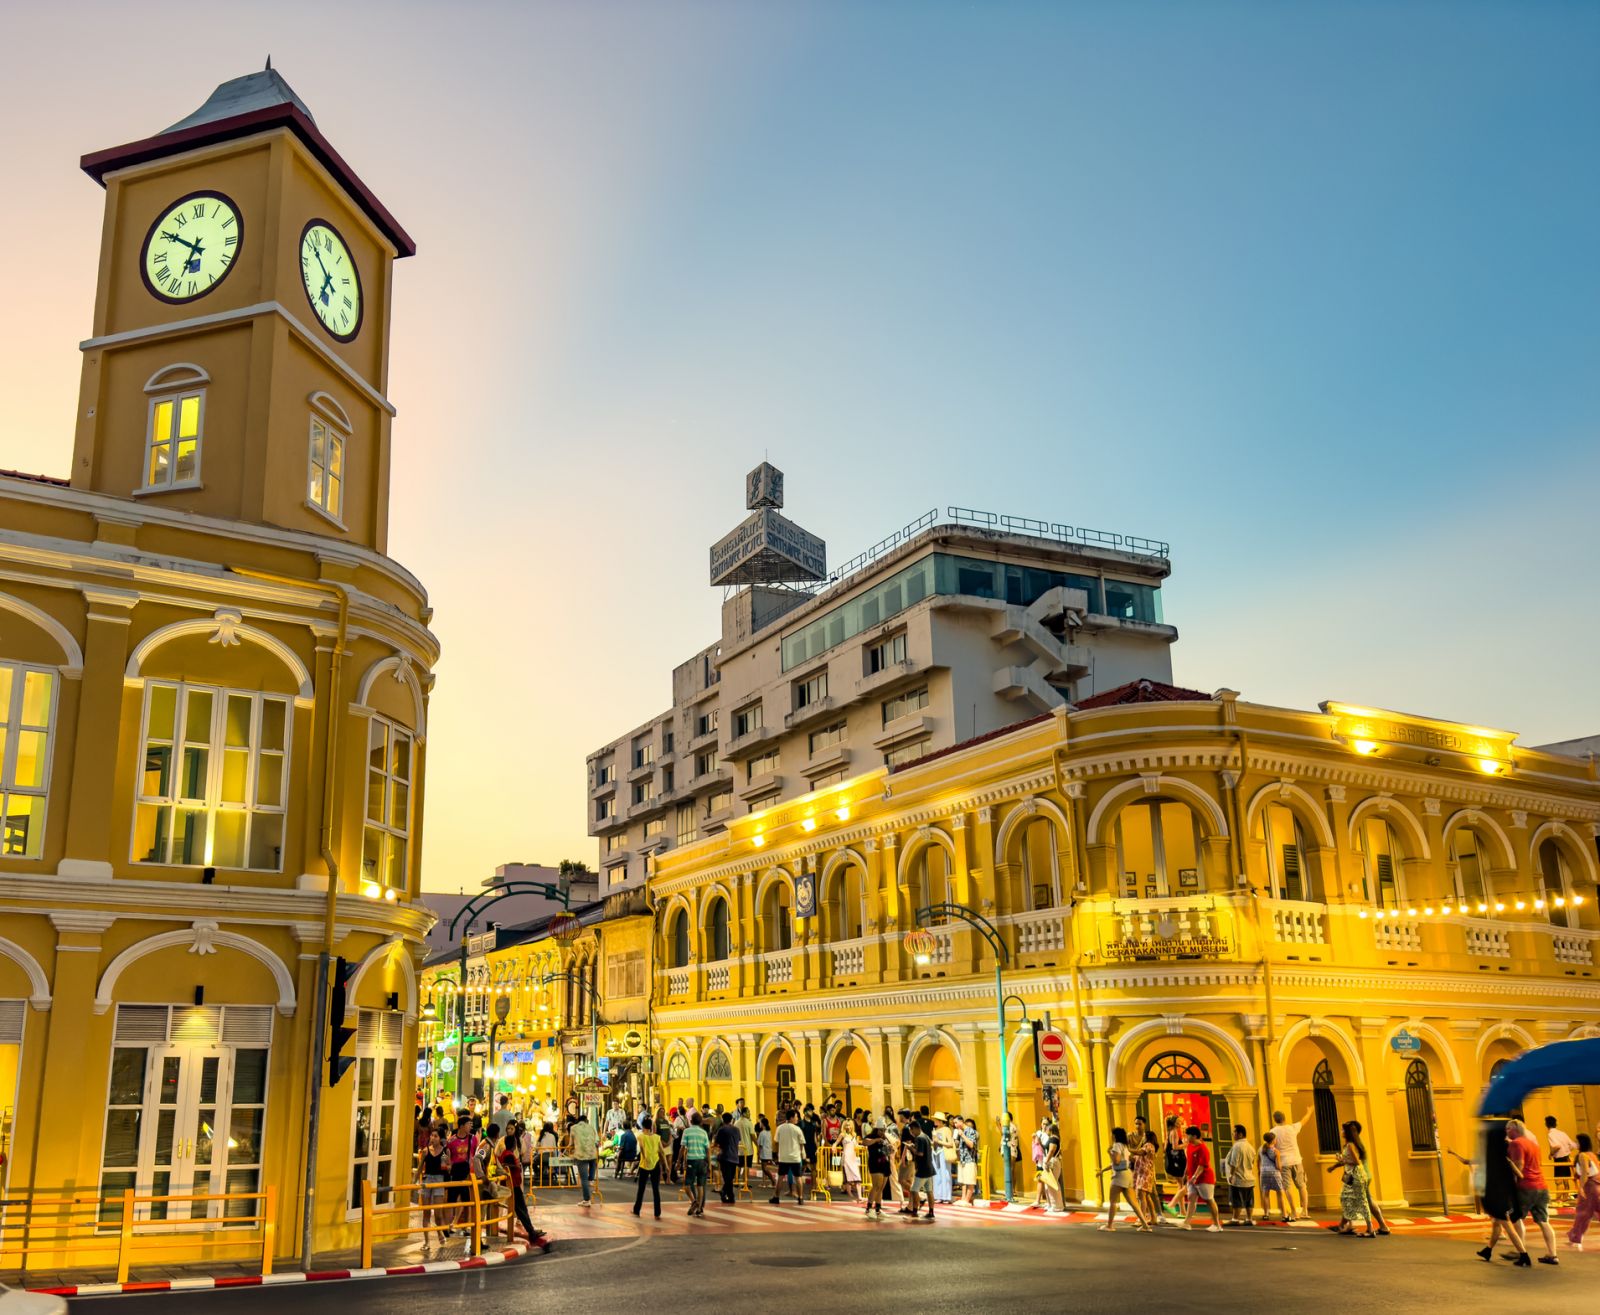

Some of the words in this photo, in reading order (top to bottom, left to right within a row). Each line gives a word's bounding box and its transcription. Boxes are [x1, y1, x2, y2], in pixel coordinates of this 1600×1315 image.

[193, 203, 205, 219] XII
[211, 204, 221, 219] I
[174, 212, 188, 229] XI
[221, 215, 235, 229] II
[225, 235, 238, 246] III
[154, 251, 168, 265] IX
[155, 265, 172, 286] VIII
[167, 277, 182, 296] VII
[188, 280, 199, 296] VI
[1107, 945, 1188, 956] PERANAKANNITAT
[1190, 945, 1229, 953] MUSEUM
